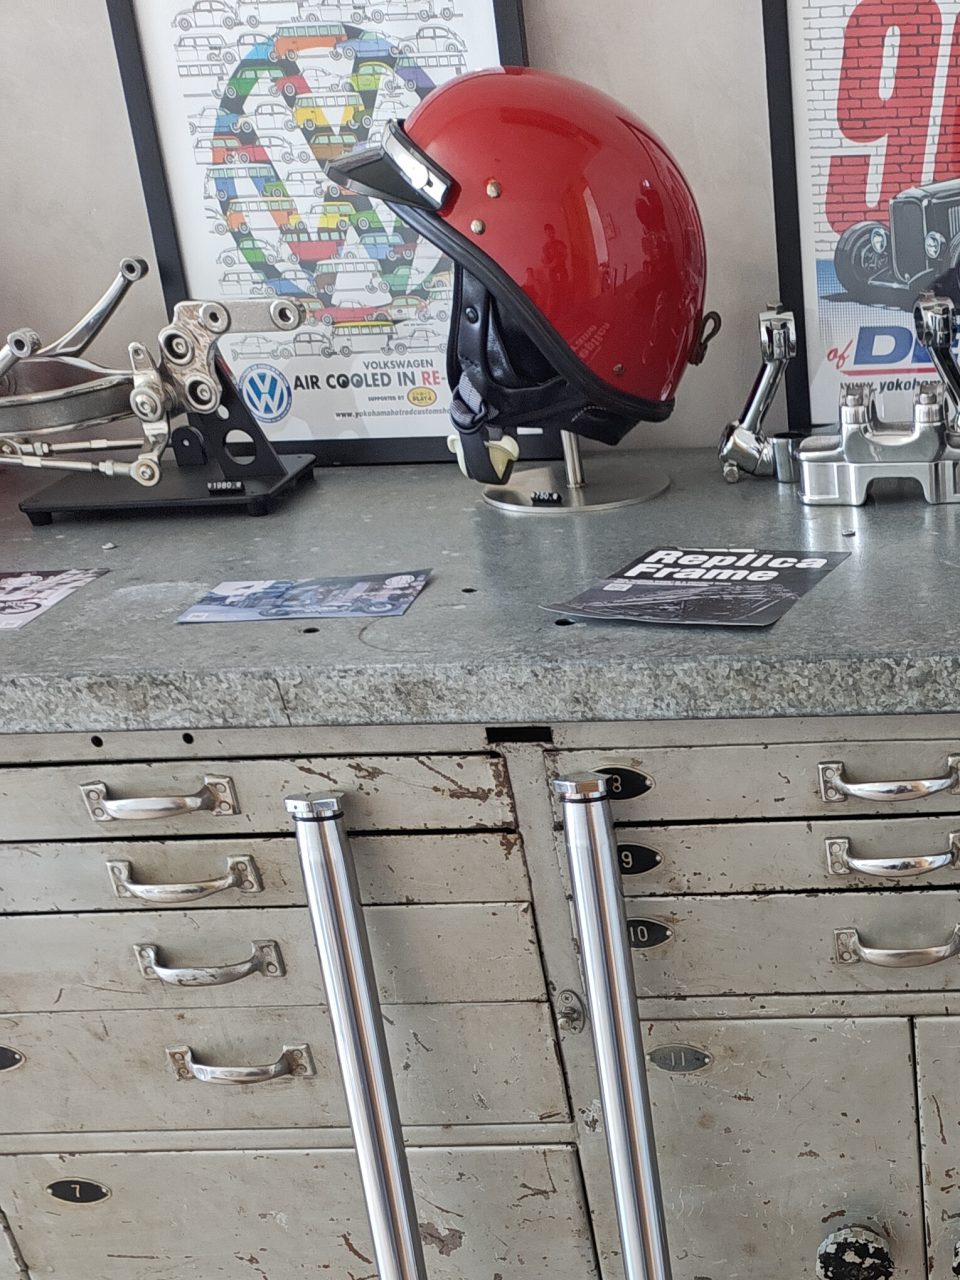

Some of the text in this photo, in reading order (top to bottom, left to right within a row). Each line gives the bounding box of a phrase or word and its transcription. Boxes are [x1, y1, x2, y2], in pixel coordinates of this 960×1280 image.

[826, 339, 853, 370] of
[363, 359, 434, 371] VOLKSWAGEN
[293, 374, 321, 391] AIR
[326, 372, 392, 389] COOLED
[397, 371, 416, 387] IN
[644, 550, 828, 569] Replica
[624, 563, 779, 581] Frame
[612, 775, 622, 793] 8
[621, 851, 633, 868] 9
[629, 925, 648, 942] 10
[671, 1051, 686, 1067] 11
[70, 1184, 81, 1198] 7
